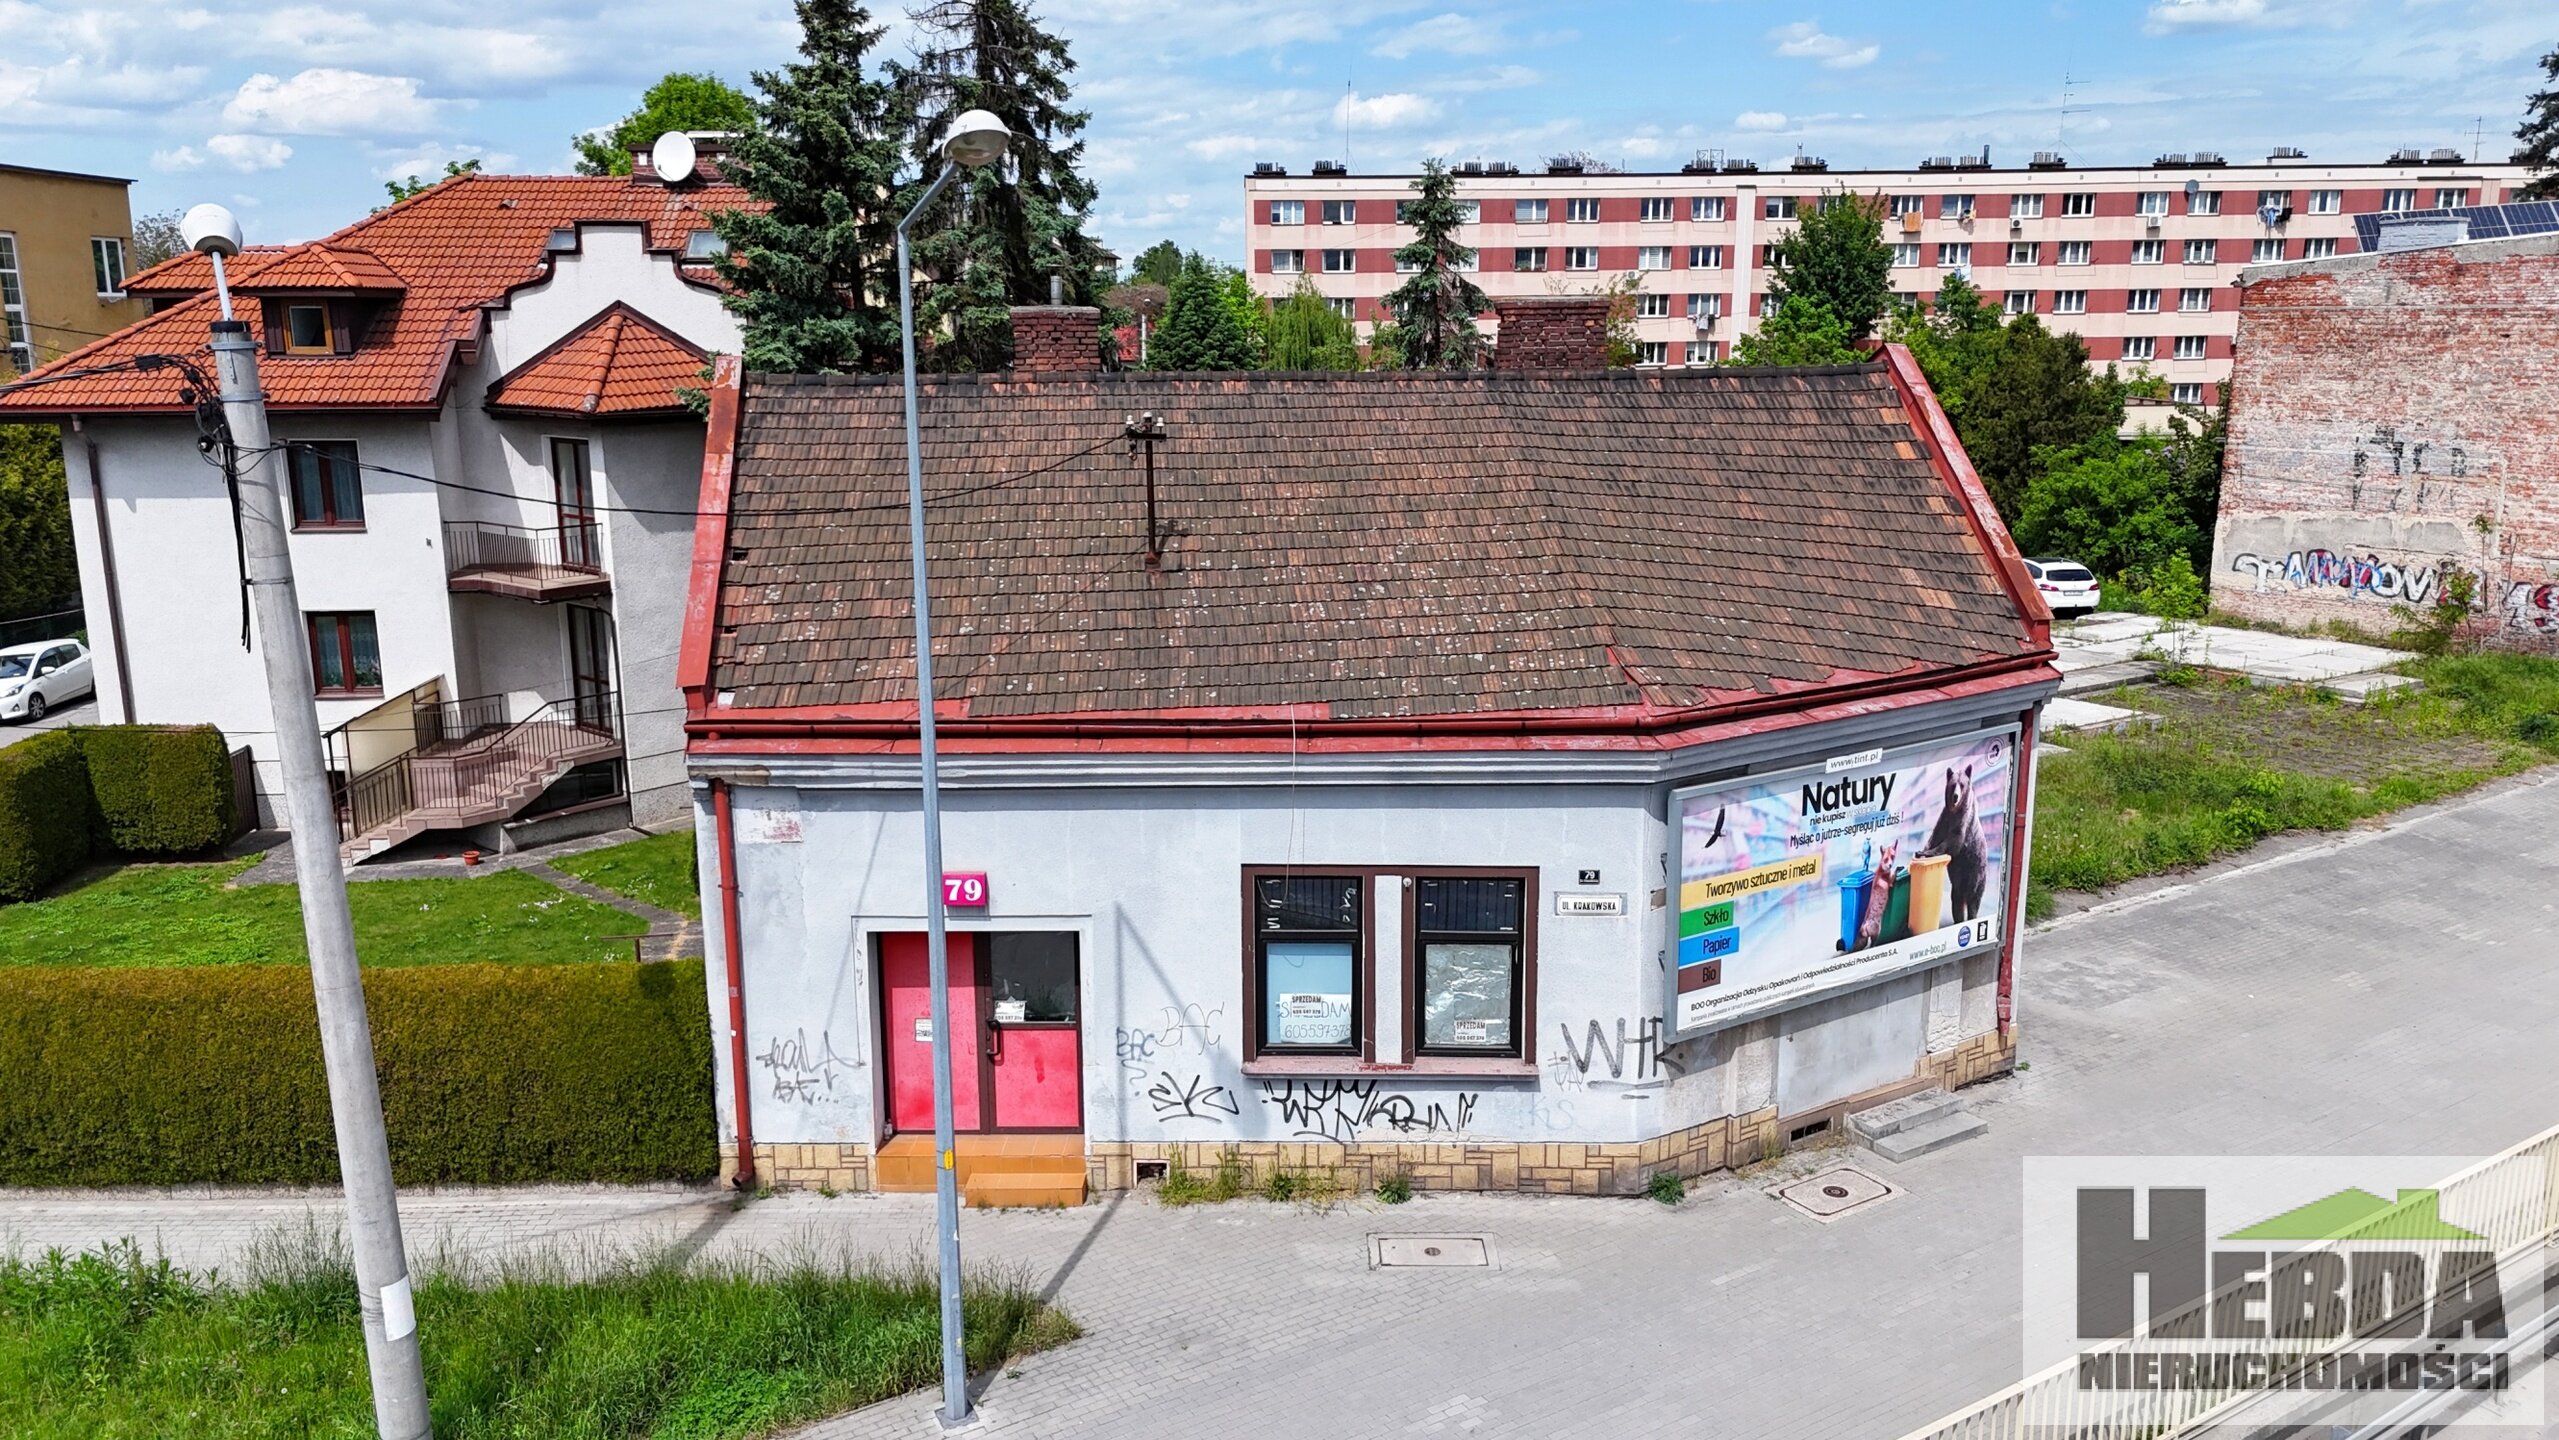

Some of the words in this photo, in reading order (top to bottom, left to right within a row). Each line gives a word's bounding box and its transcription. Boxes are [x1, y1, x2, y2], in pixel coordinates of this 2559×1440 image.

[1802, 773, 1896, 816] Natury
[1810, 815, 1821, 826] nie
[1822, 811, 1846, 824] kupisz
[1790, 832, 1814, 849] Myśląc
[1815, 832, 1821, 842] o
[1584, 870, 1595, 880] 79
[1706, 876, 1749, 898] Tworzywo
[1750, 870, 1788, 888] sztuczne
[1788, 864, 1792, 879] i
[1792, 859, 1817, 878] metal
[944, 879, 983, 902] 79
[1573, 901, 1617, 911] KRAKOWSKA
[1703, 907, 1729, 926] Szkło
[1703, 935, 1732, 955] Papier
[1691, 1001, 1705, 1011] BOO
[1705, 991, 1742, 1007] Organizacja
[1743, 983, 1768, 997] Odzysku
[1855, 950, 1888, 965] Producenta
[1702, 966, 1717, 983] Bio
[1291, 995, 1322, 1004] SPRZEDAM
[1456, 1021, 1486, 1030] SPRZEDAM
